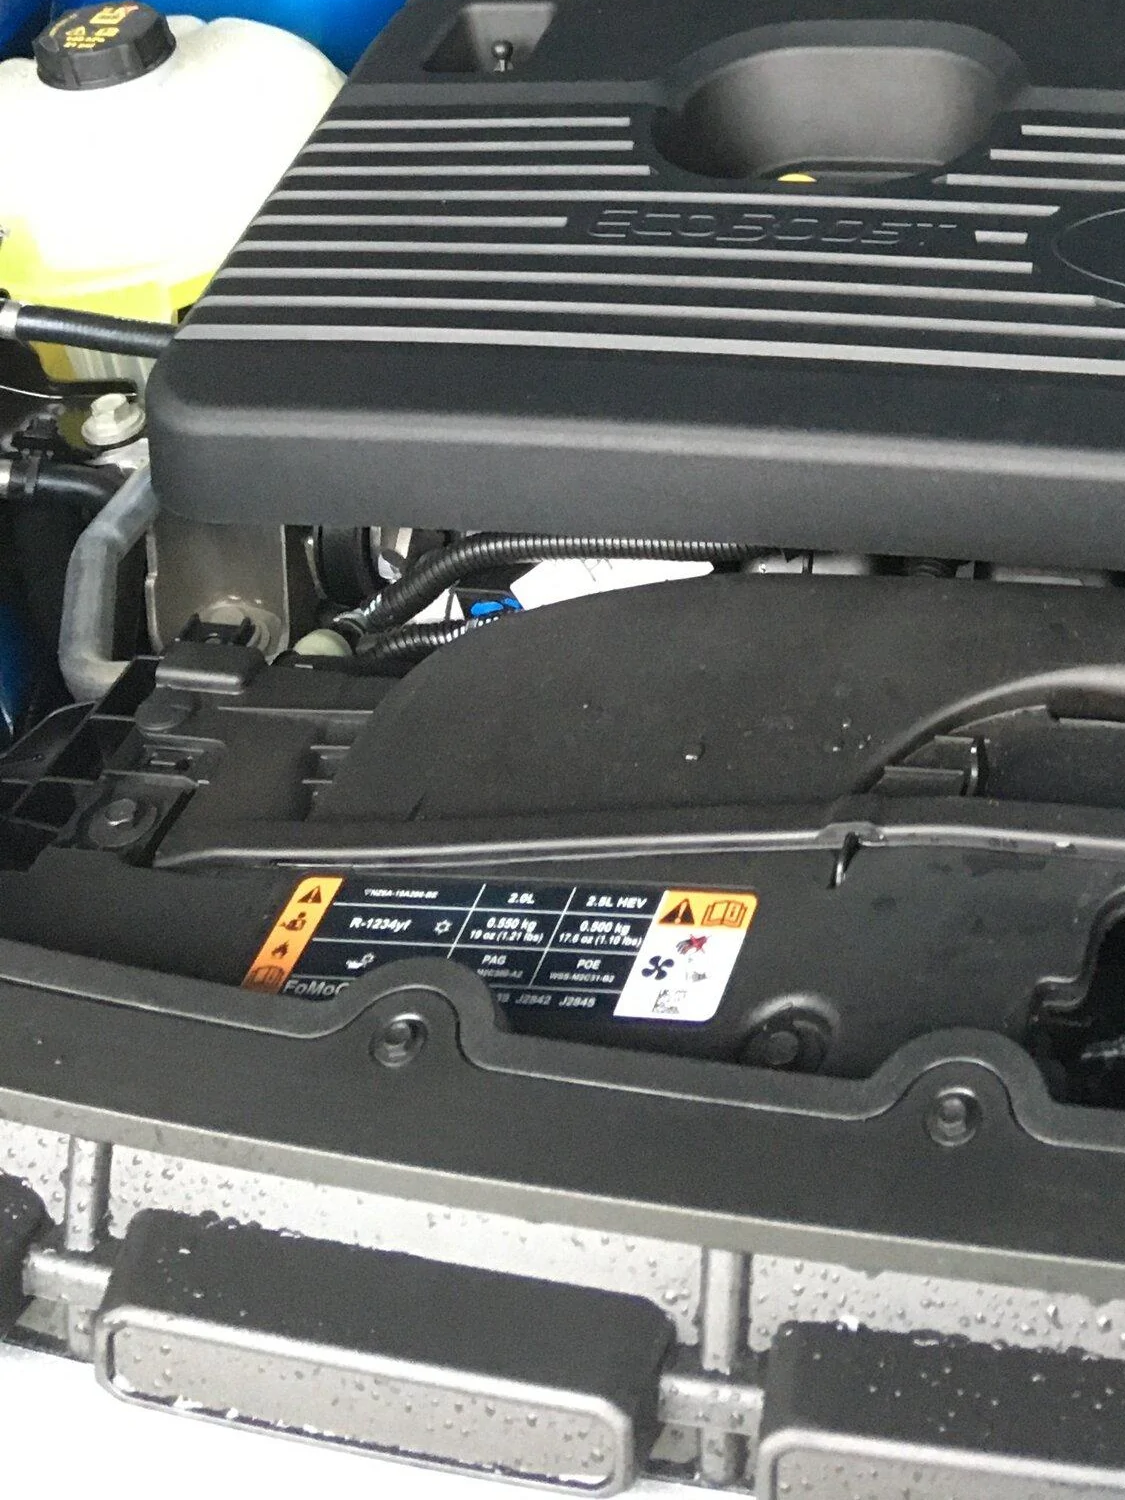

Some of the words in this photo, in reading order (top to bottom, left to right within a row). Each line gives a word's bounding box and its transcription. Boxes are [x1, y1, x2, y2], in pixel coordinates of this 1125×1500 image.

[588, 208, 957, 246] ECOBOOST
[507, 892, 536, 905] 2.0L
[616, 896, 648, 909] HEV
[350, 916, 413, 932] R-1234yf
[486, 917, 520, 930] 0.550
[520, 917, 538, 933] kg
[579, 920, 614, 933] 0.500
[614, 921, 632, 936] kg
[483, 932, 496, 940] oz
[496, 931, 520, 942] (1.21
[523, 932, 545, 944] lbs)
[580, 935, 594, 944] oz
[621, 936, 643, 948] lbs)
[481, 955, 507, 965] PAG
[576, 959, 602, 970] POE
[282, 980, 350, 997] FoMoC
